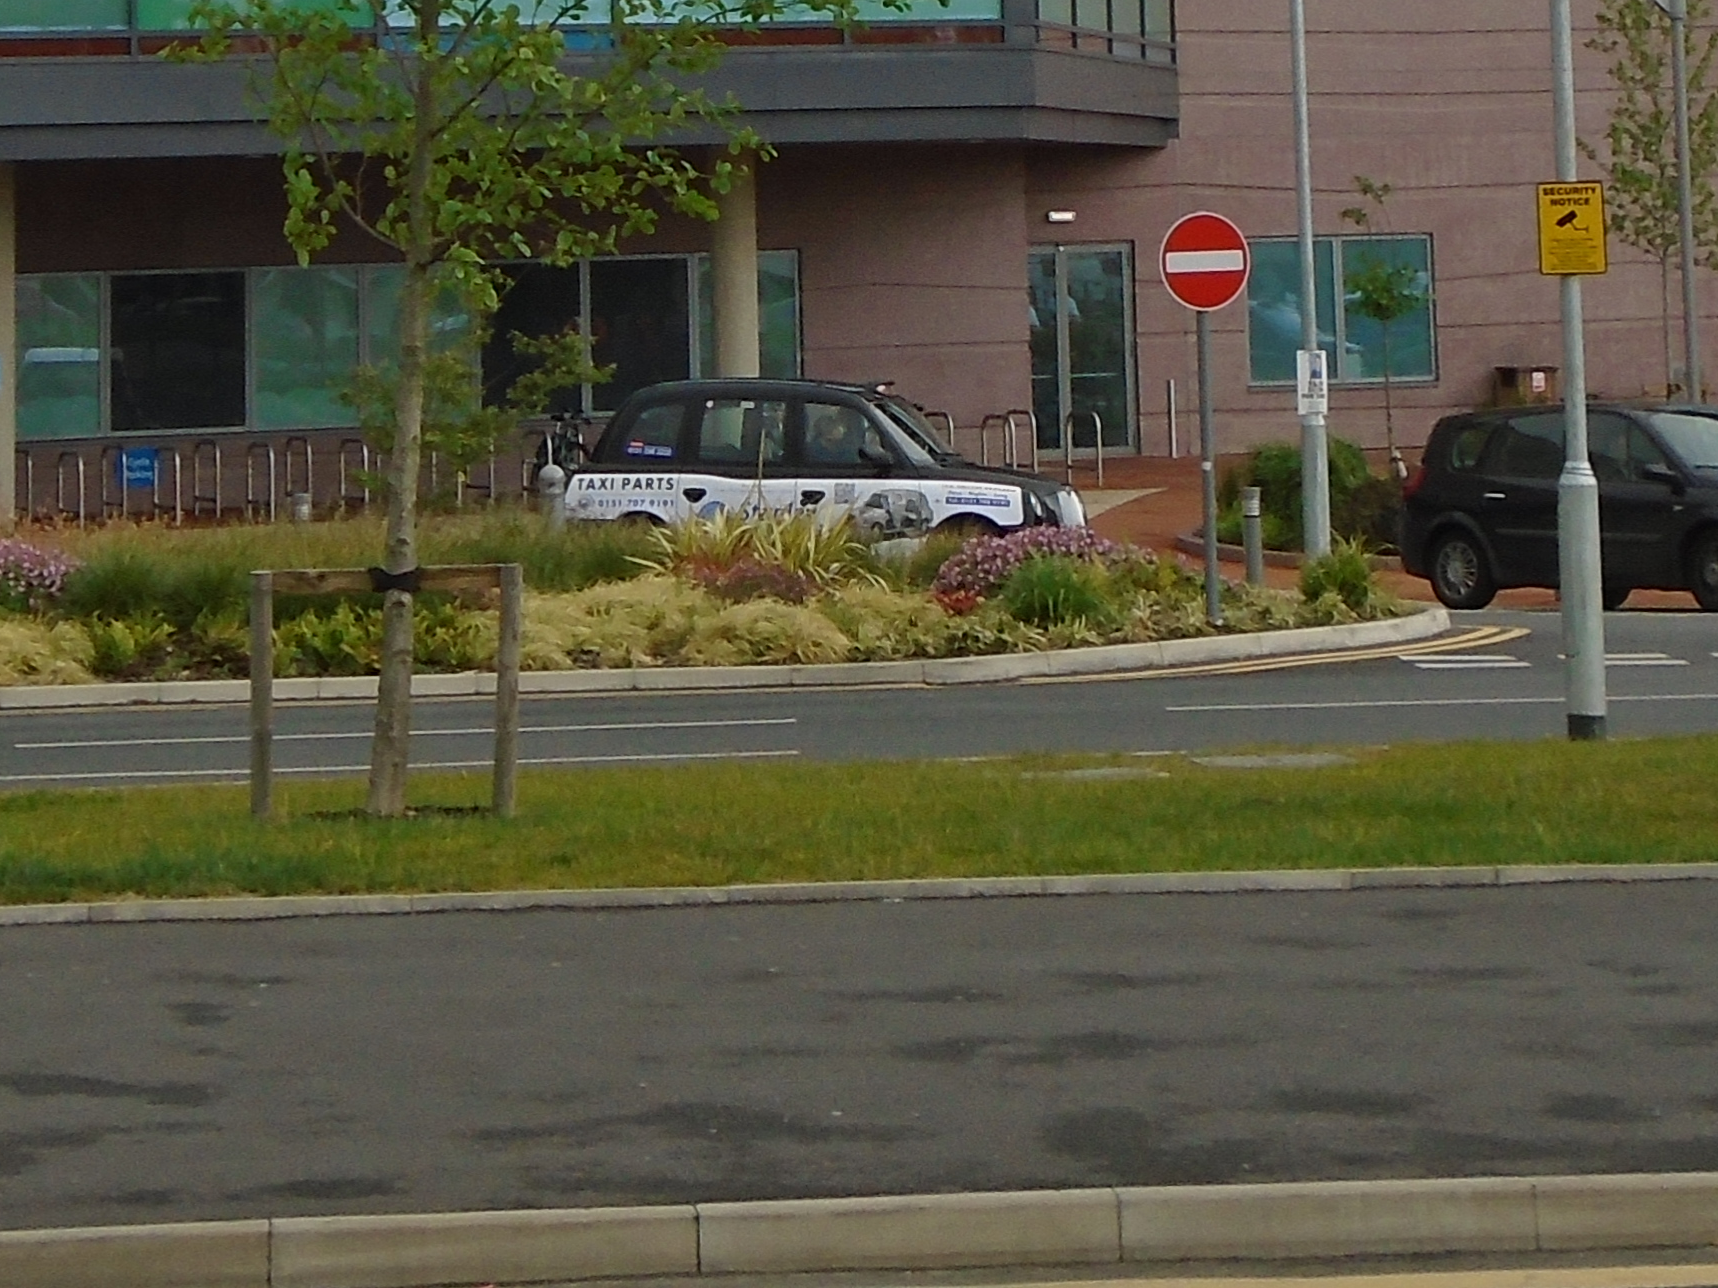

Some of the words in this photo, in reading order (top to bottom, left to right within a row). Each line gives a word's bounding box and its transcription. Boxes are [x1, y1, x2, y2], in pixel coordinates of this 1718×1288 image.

[1543, 187, 1596, 196] SECURITY
[1550, 197, 1590, 206] NOTICE
[577, 477, 615, 491] TAXI
[621, 477, 674, 491] PARTS
[597, 499, 622, 507] 0151
